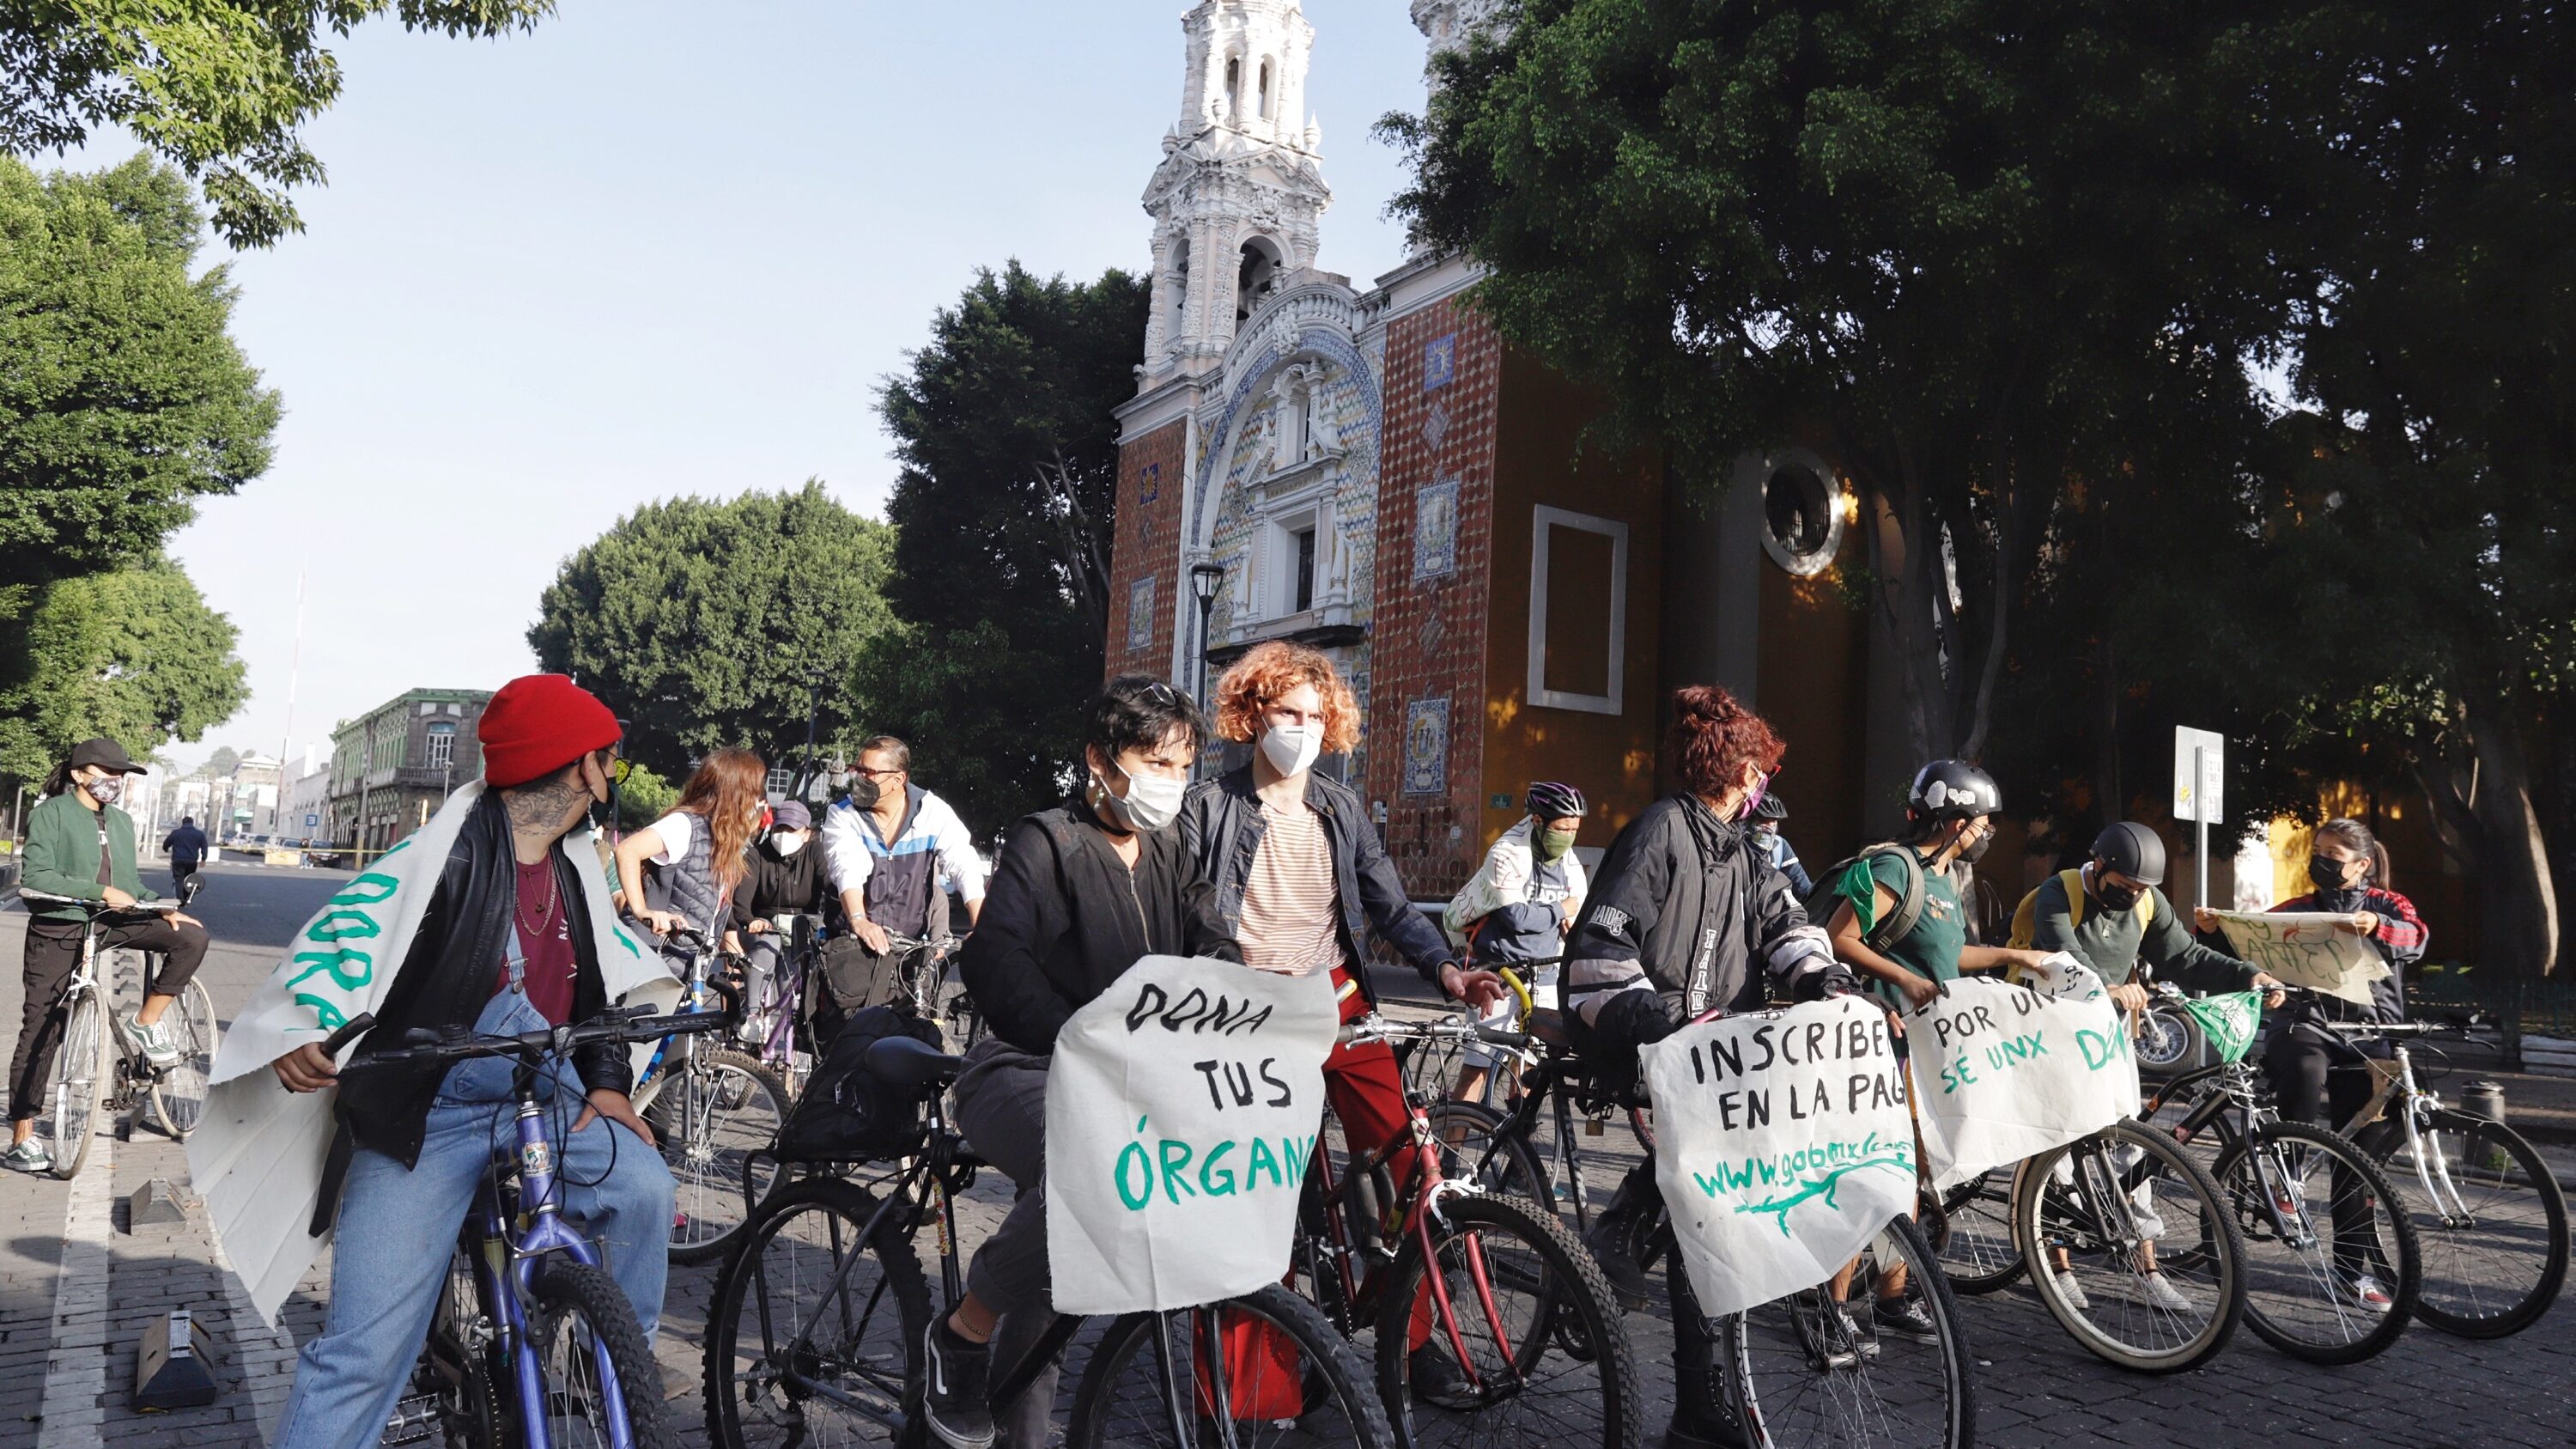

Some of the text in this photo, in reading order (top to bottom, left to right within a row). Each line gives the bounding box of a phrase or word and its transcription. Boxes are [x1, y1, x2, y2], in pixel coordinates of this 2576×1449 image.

[284, 840, 410, 1031] DORA
[2227, 932, 2349, 985] ANTES
[1691, 928, 1716, 1019] RAID
[1126, 983, 1273, 1036] DONA
[1934, 1006, 1996, 1048] POR
[1691, 1002, 1890, 1084] INSCRÍBE
[1941, 1045, 1978, 1094] SÉ
[1986, 1030, 2049, 1070] UNX
[1194, 1057, 1291, 1111] TUS
[1719, 1087, 1770, 1130] EN
[1790, 1078, 1831, 1119] LA
